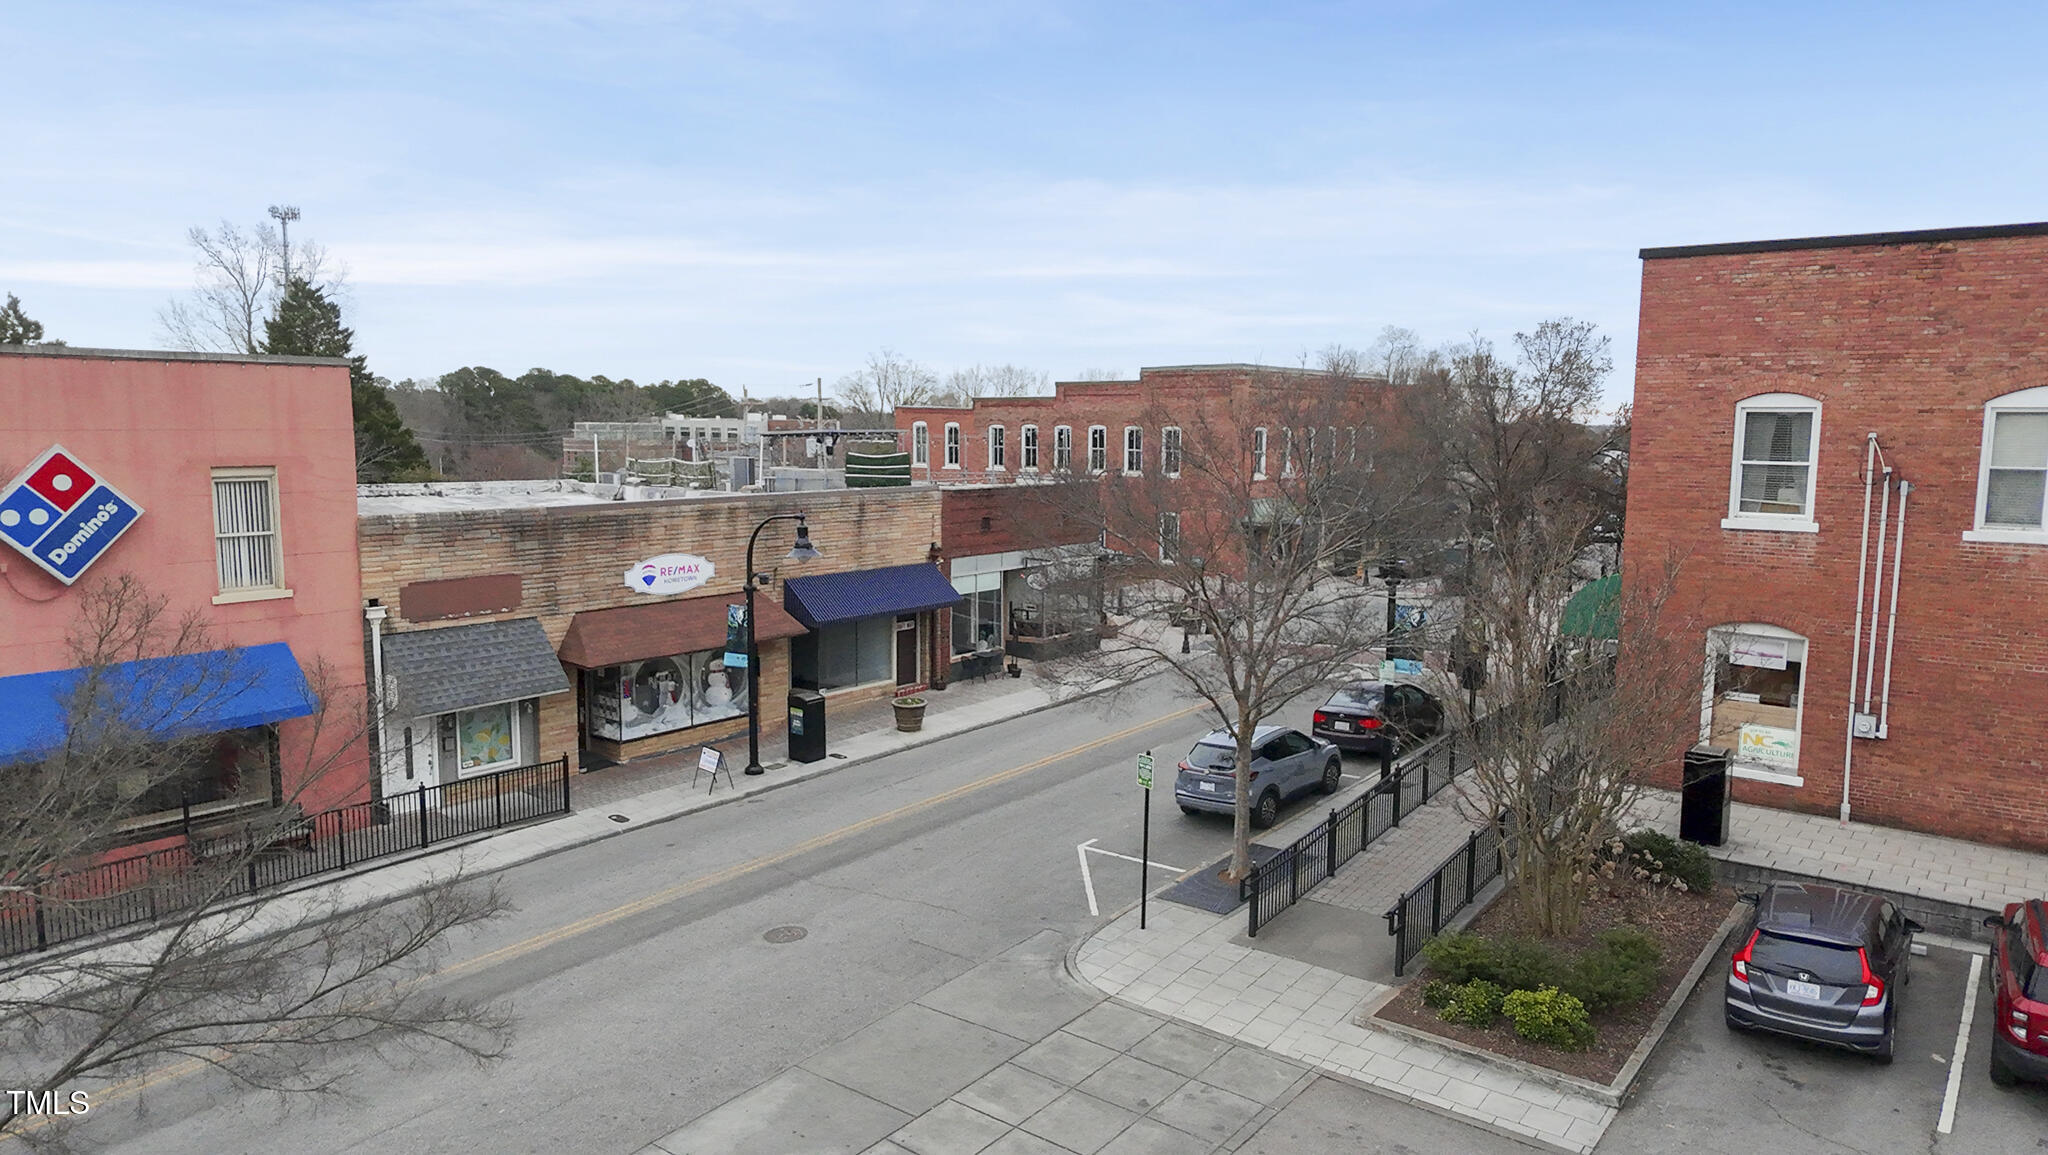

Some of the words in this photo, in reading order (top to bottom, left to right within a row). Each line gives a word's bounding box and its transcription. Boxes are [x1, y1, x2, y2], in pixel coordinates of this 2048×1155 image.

[48, 502, 118, 565] Domino's
[660, 564, 700, 577] RE/MAX
[1743, 732, 1775, 748] NC
